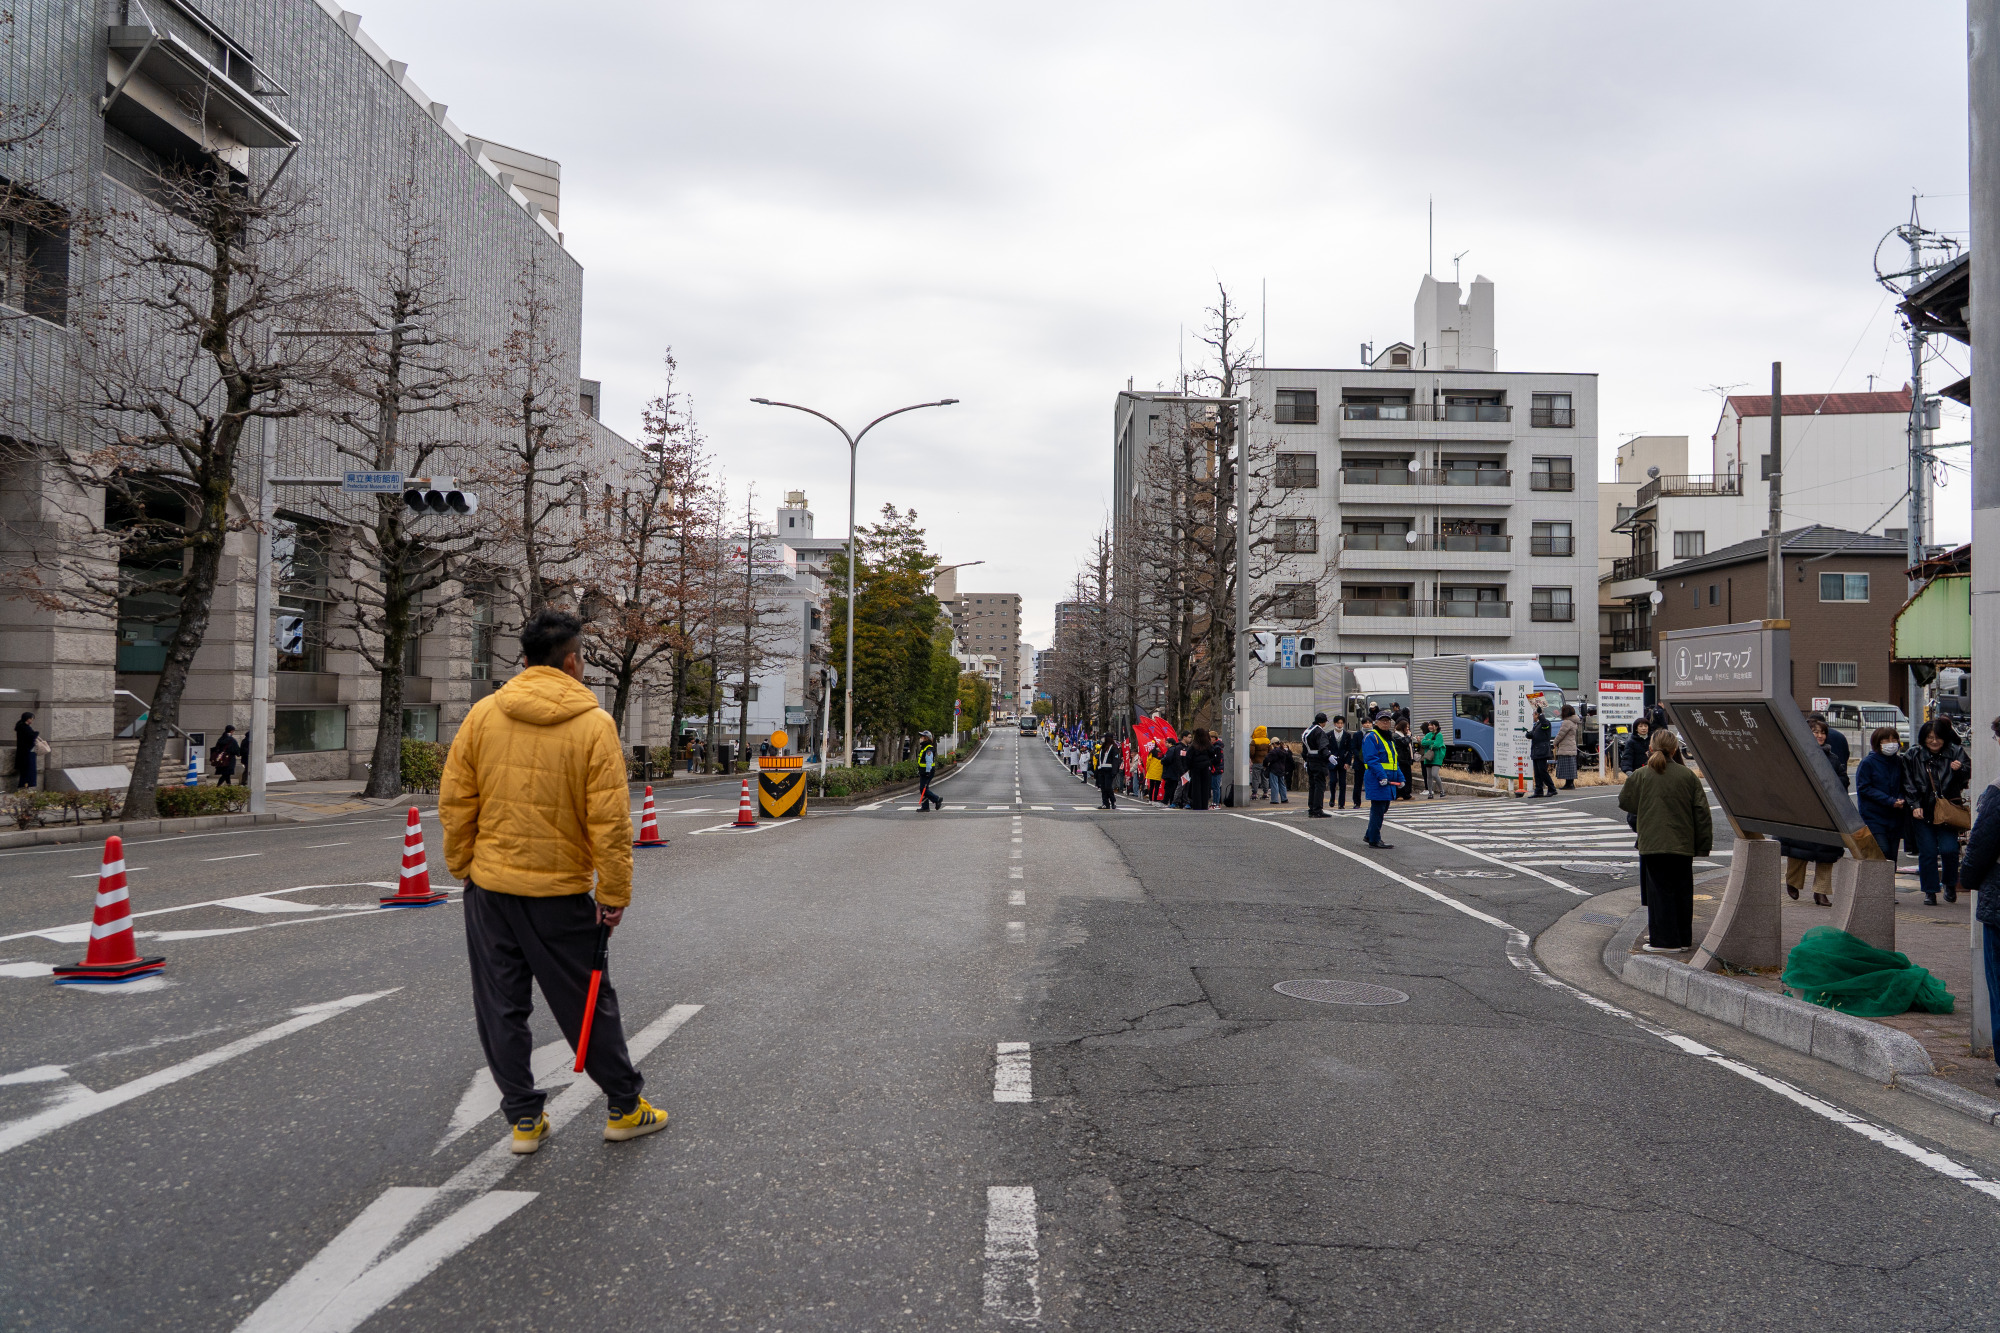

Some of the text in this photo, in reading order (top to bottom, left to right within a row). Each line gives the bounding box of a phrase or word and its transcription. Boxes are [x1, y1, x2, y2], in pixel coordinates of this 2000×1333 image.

[347, 474, 400, 484] 県立美術館前
[1694, 646, 1752, 670] エリアマップ
[1690, 709, 1758, 728] 城下筋
